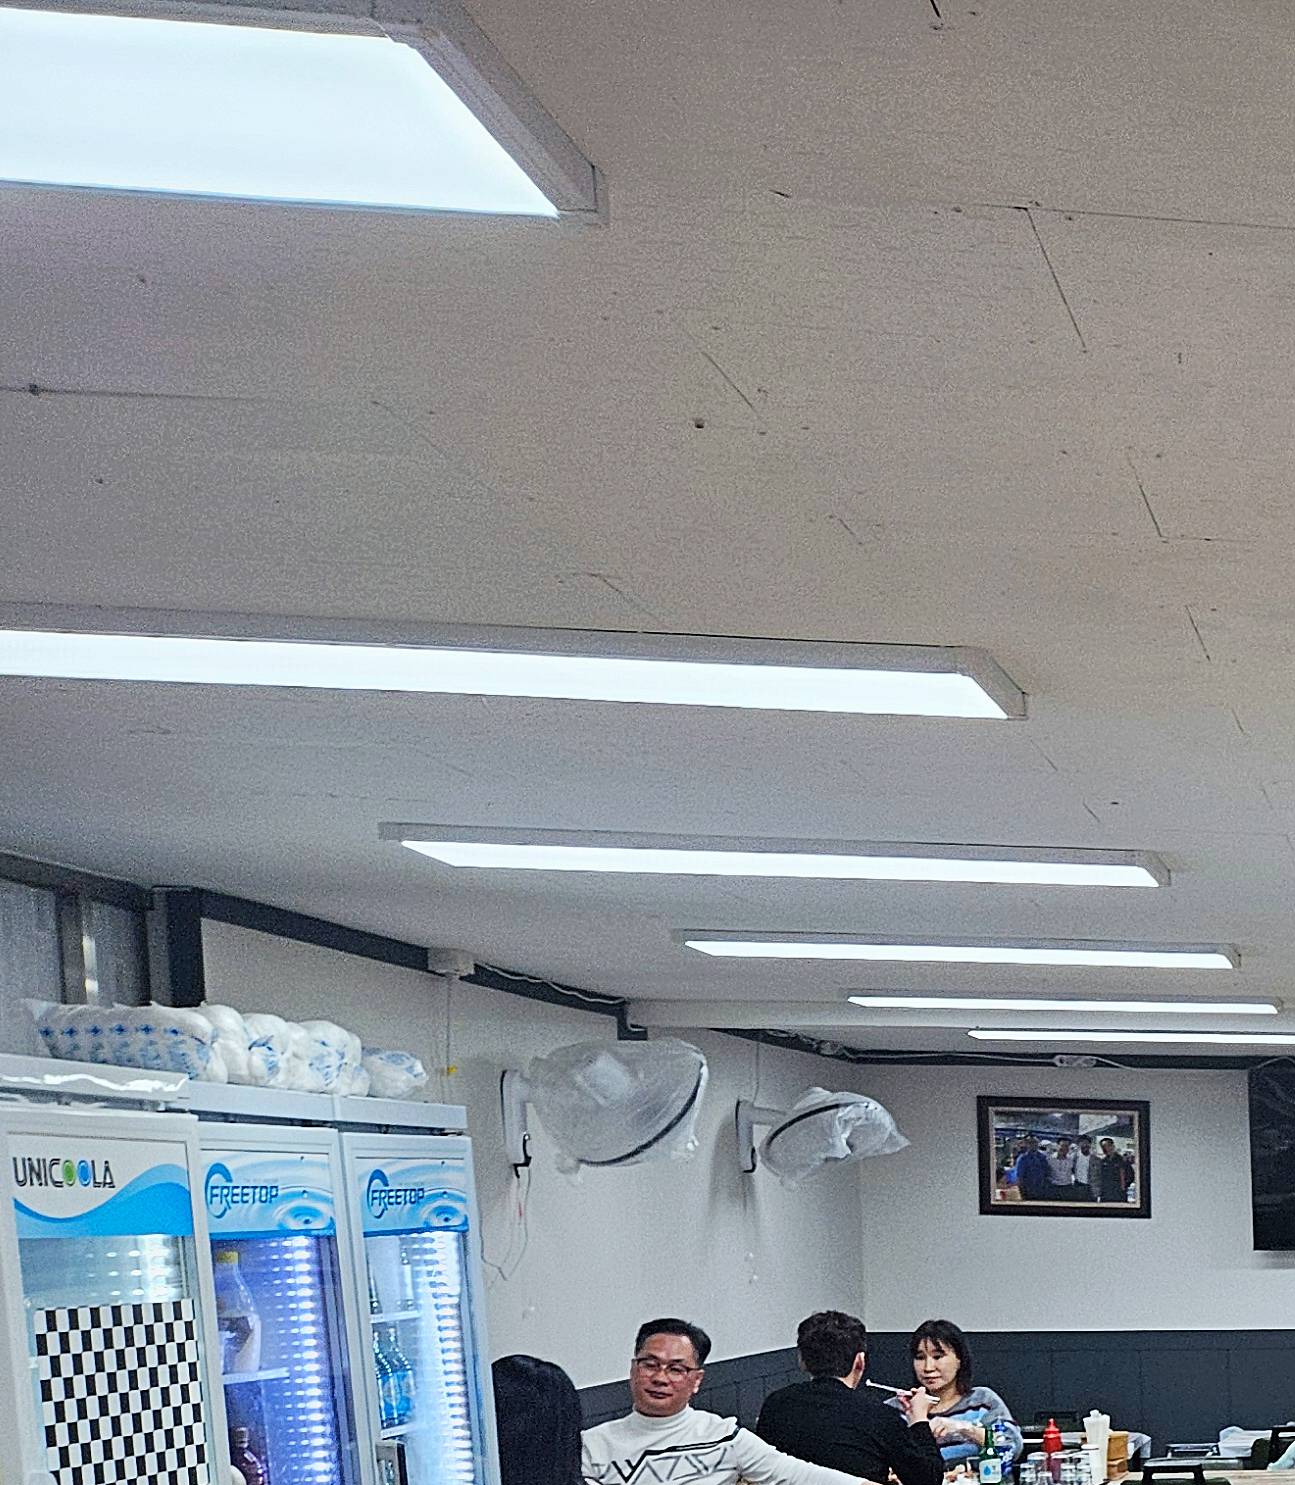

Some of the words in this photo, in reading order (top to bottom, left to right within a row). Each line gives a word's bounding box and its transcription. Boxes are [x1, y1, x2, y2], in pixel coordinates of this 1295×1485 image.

[12, 1157, 116, 1188] UNICOOLA
[208, 1185, 279, 1210] FREETOP
[371, 1187, 425, 1210] FREETOP
